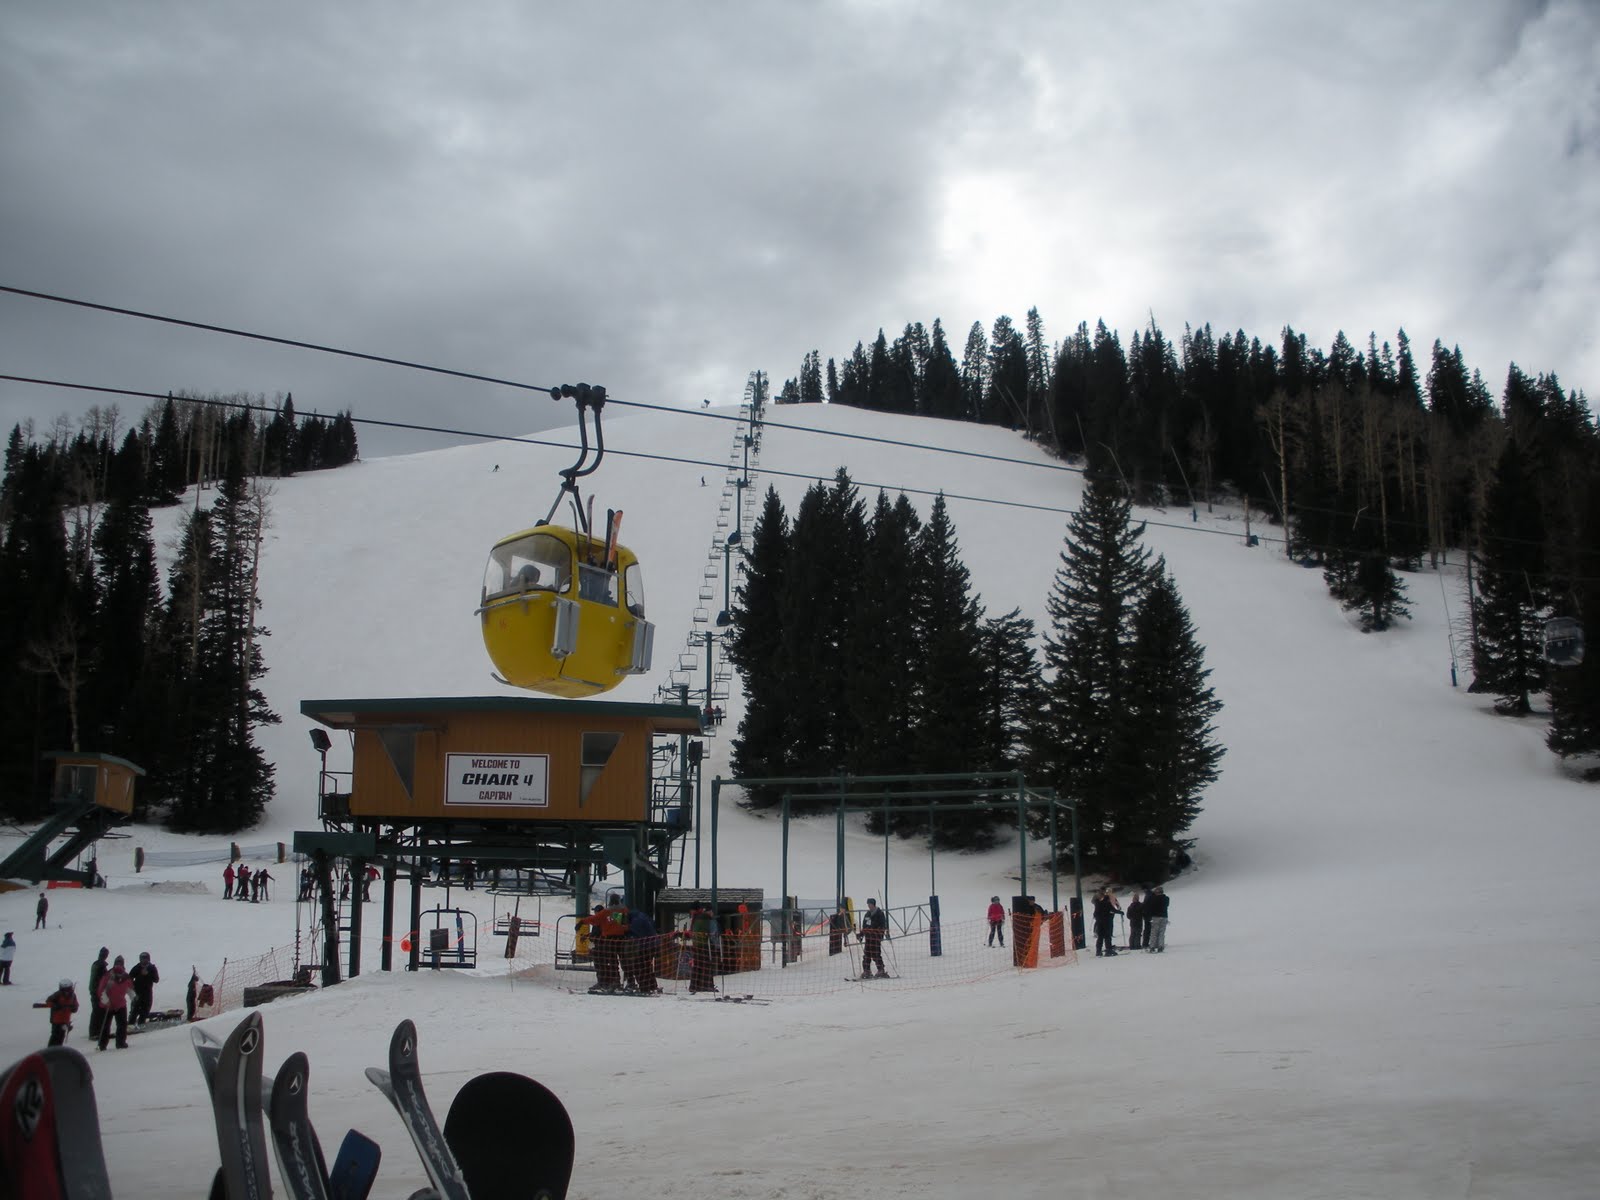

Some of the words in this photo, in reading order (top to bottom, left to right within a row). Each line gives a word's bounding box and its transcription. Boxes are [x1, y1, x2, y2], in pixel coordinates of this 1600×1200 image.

[472, 759, 508, 769] WELCOME
[510, 760, 521, 769] TO
[462, 773, 519, 786] CHAIR
[523, 774, 534, 786] 4
[479, 791, 512, 801] CAPITAN
